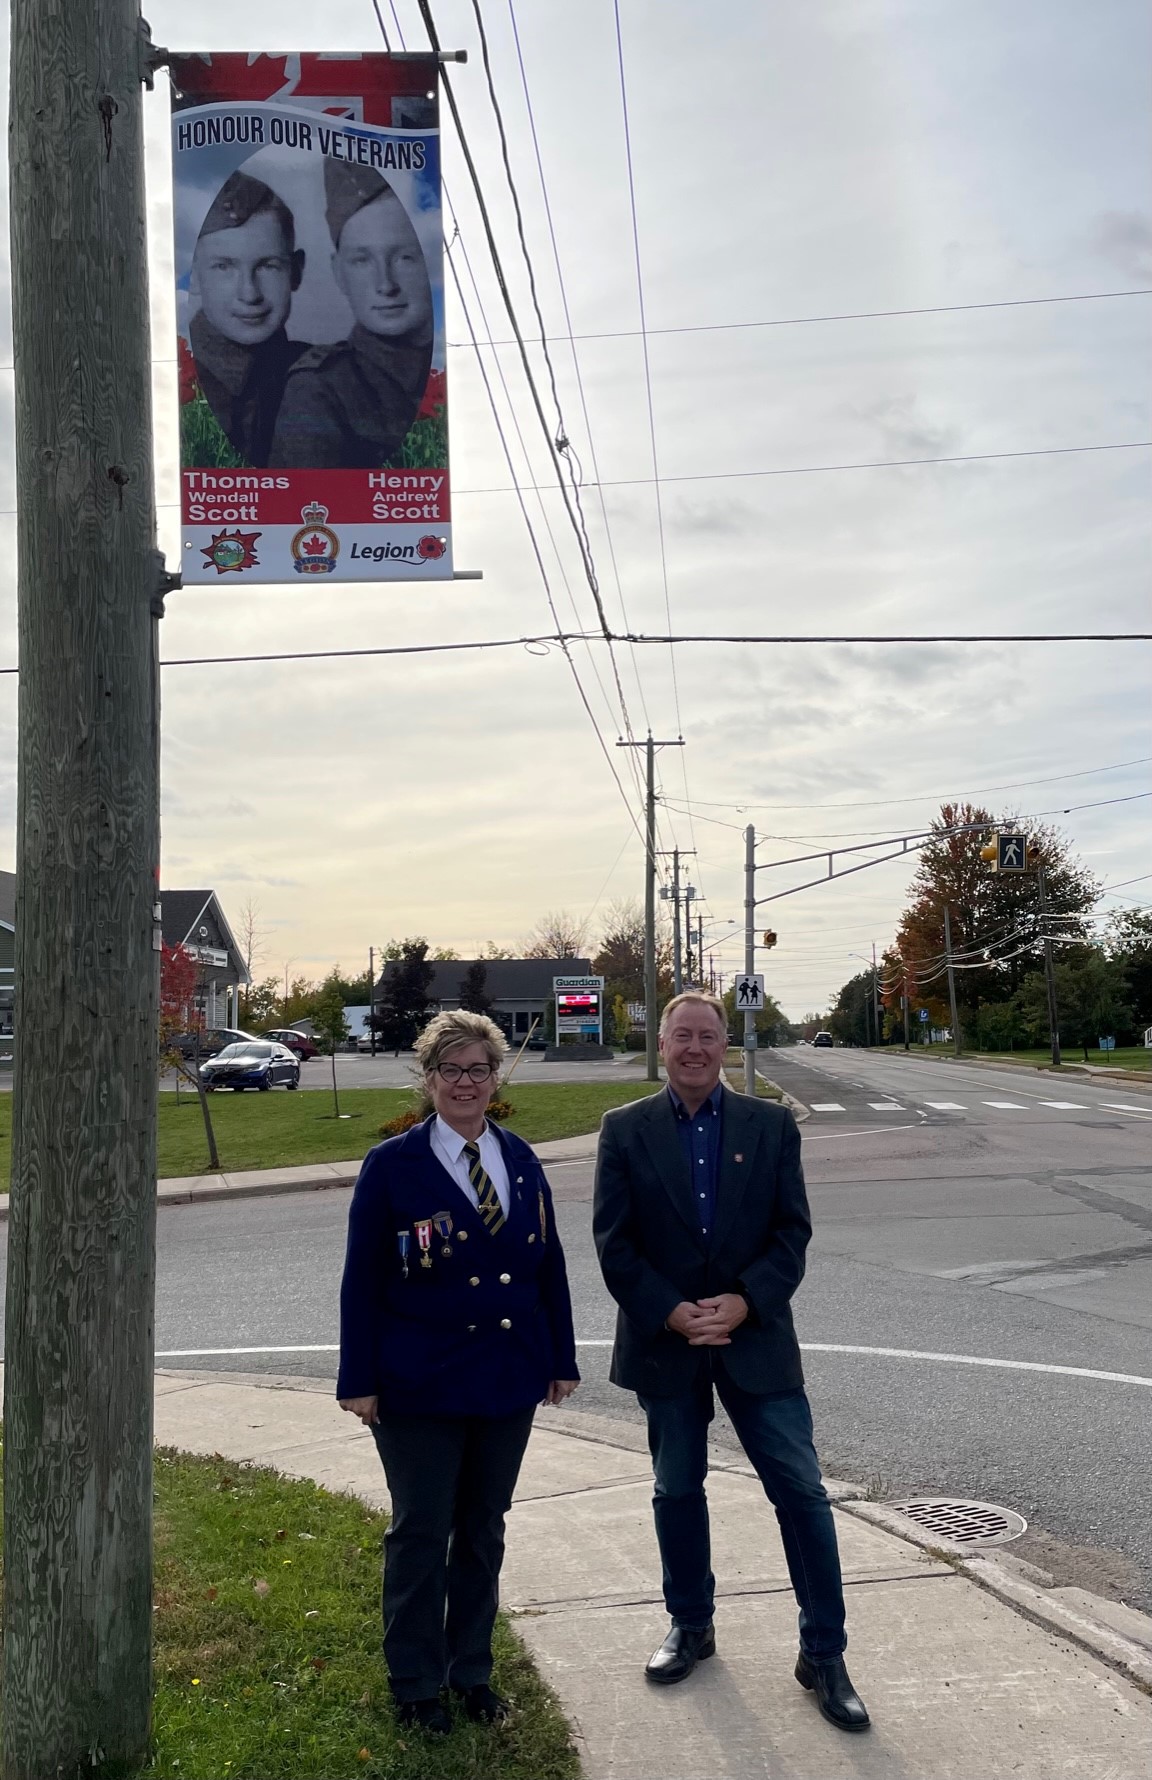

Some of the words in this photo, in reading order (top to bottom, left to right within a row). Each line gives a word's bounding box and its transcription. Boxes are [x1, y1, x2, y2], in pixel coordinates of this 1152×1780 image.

[178, 116, 264, 150] HONOUR
[270, 117, 312, 151] OUR
[317, 127, 426, 170] VETERANS
[183, 472, 290, 489] Thomas
[368, 473, 444, 491] Henry
[188, 492, 259, 503] Wendall
[372, 491, 438, 502] Andrew
[188, 505, 258, 521] Scott
[372, 503, 440, 519] Scott
[350, 542, 415, 562] Legion
